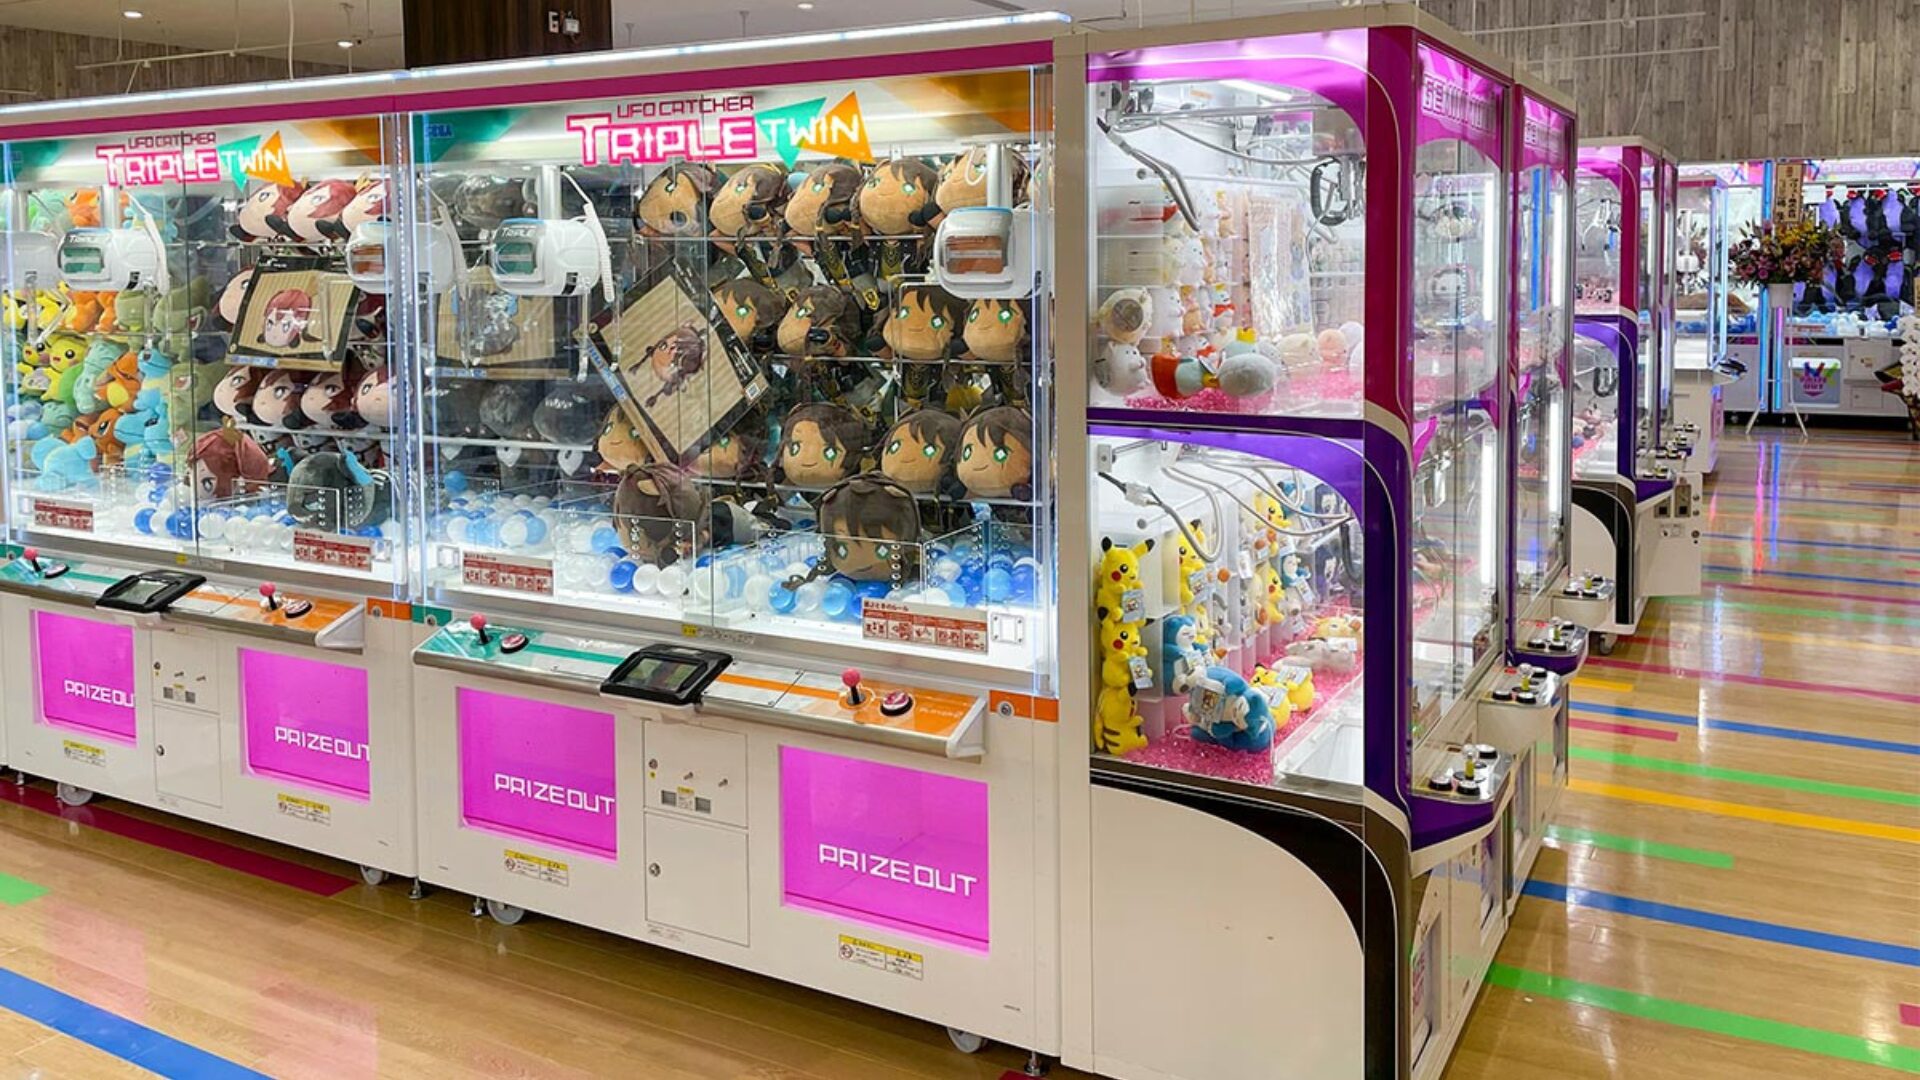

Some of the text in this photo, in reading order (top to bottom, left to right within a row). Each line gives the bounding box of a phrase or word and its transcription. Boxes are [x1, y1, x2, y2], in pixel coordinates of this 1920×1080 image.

[617, 96, 754, 119] UFO CATCHER
[128, 132, 217, 150] UFO CATCHER
[567, 113, 860, 167] TRIPLE TWIN
[96, 144, 283, 187] TRIPLE TWIN
